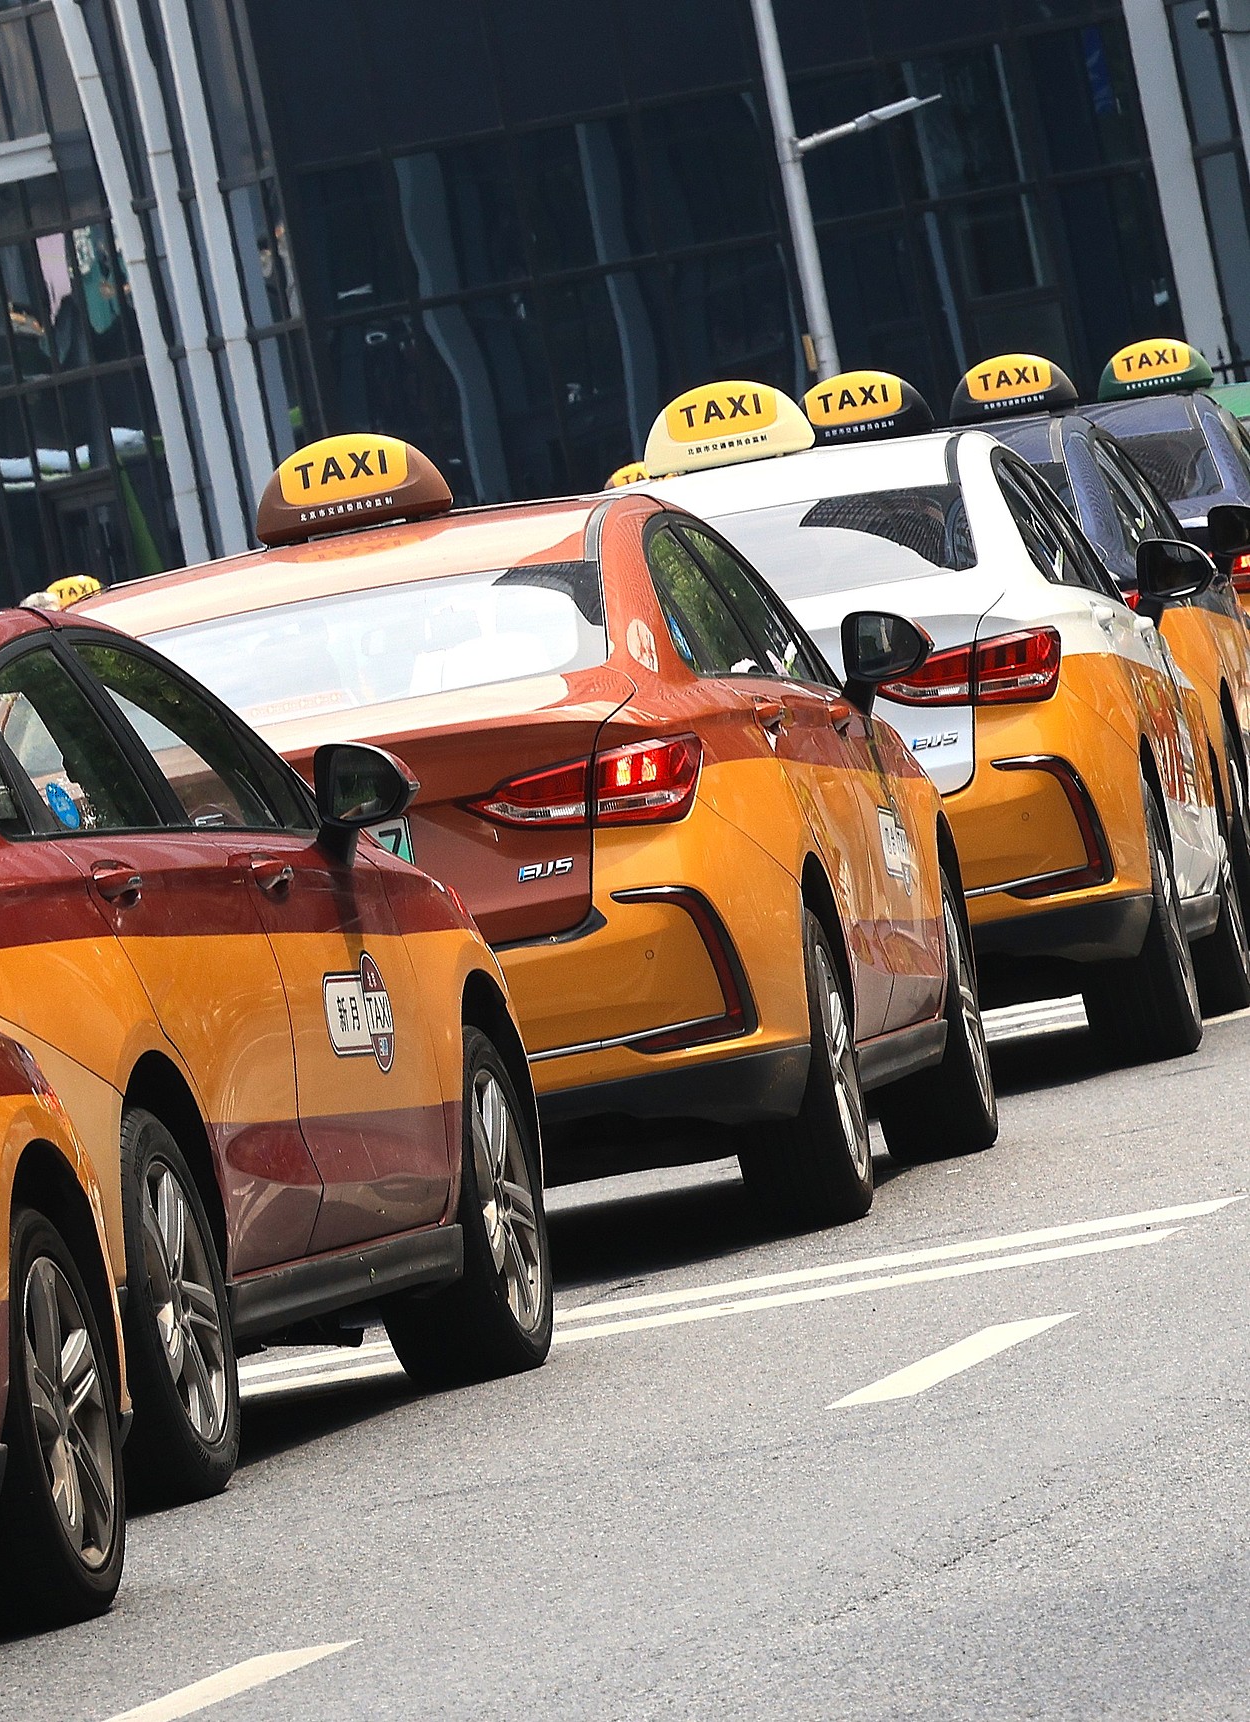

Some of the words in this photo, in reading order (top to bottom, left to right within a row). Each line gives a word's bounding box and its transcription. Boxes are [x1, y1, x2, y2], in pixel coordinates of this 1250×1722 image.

[1121, 348, 1178, 372] TAXI
[978, 366, 1040, 391] TAXI
[679, 393, 762, 428] TAXI
[817, 384, 889, 414] TAXI
[294, 449, 388, 490] TAXI
[57, 582, 94, 599] TAXI
[378, 828, 403, 854] 7
[366, 996, 391, 1030] TAXI
